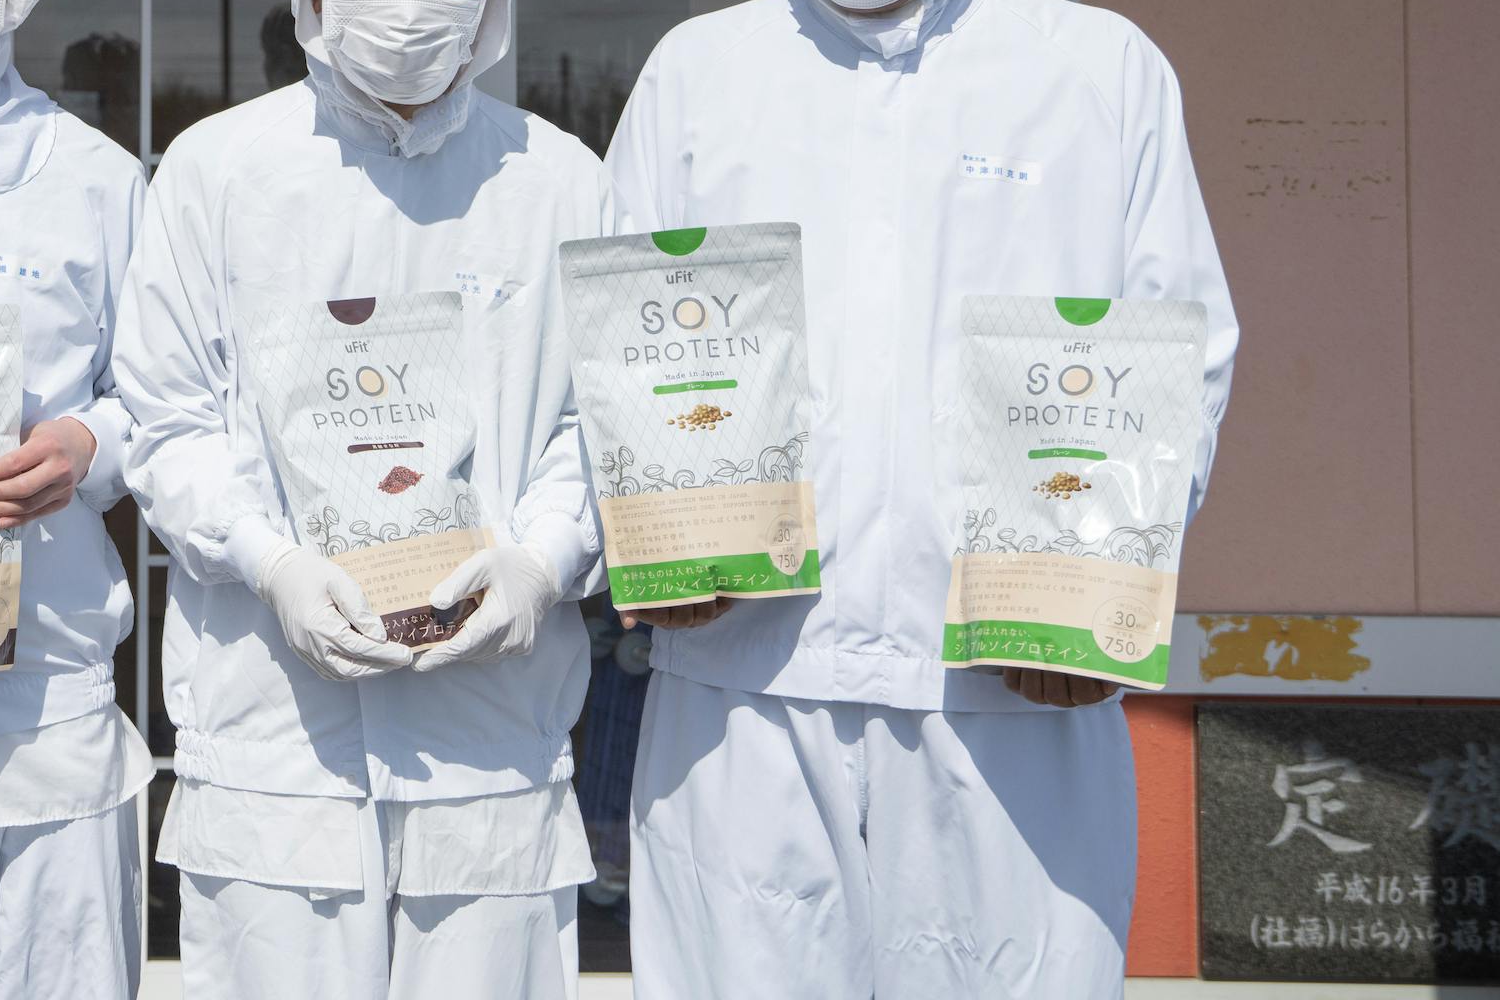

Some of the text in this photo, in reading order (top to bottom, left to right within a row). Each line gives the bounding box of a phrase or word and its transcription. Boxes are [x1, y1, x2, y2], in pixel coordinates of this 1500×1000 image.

[666, 270, 694, 284] uFit
[640, 294, 738, 334] SOY
[345, 341, 368, 354] uFit
[624, 336, 760, 366] PROTEIN
[1063, 342, 1092, 354] uFit
[327, 364, 408, 401] SOY
[665, 372, 686, 380] Made
[700, 370, 724, 378] Japan
[1026, 362, 1132, 398] SOY
[312, 402, 436, 430] PROTEIN
[1008, 405, 1144, 433] PROTEIN
[624, 574, 770, 596] シンプルソイプロテイン
[1315, 873, 1486, 905] 平成16年3月
